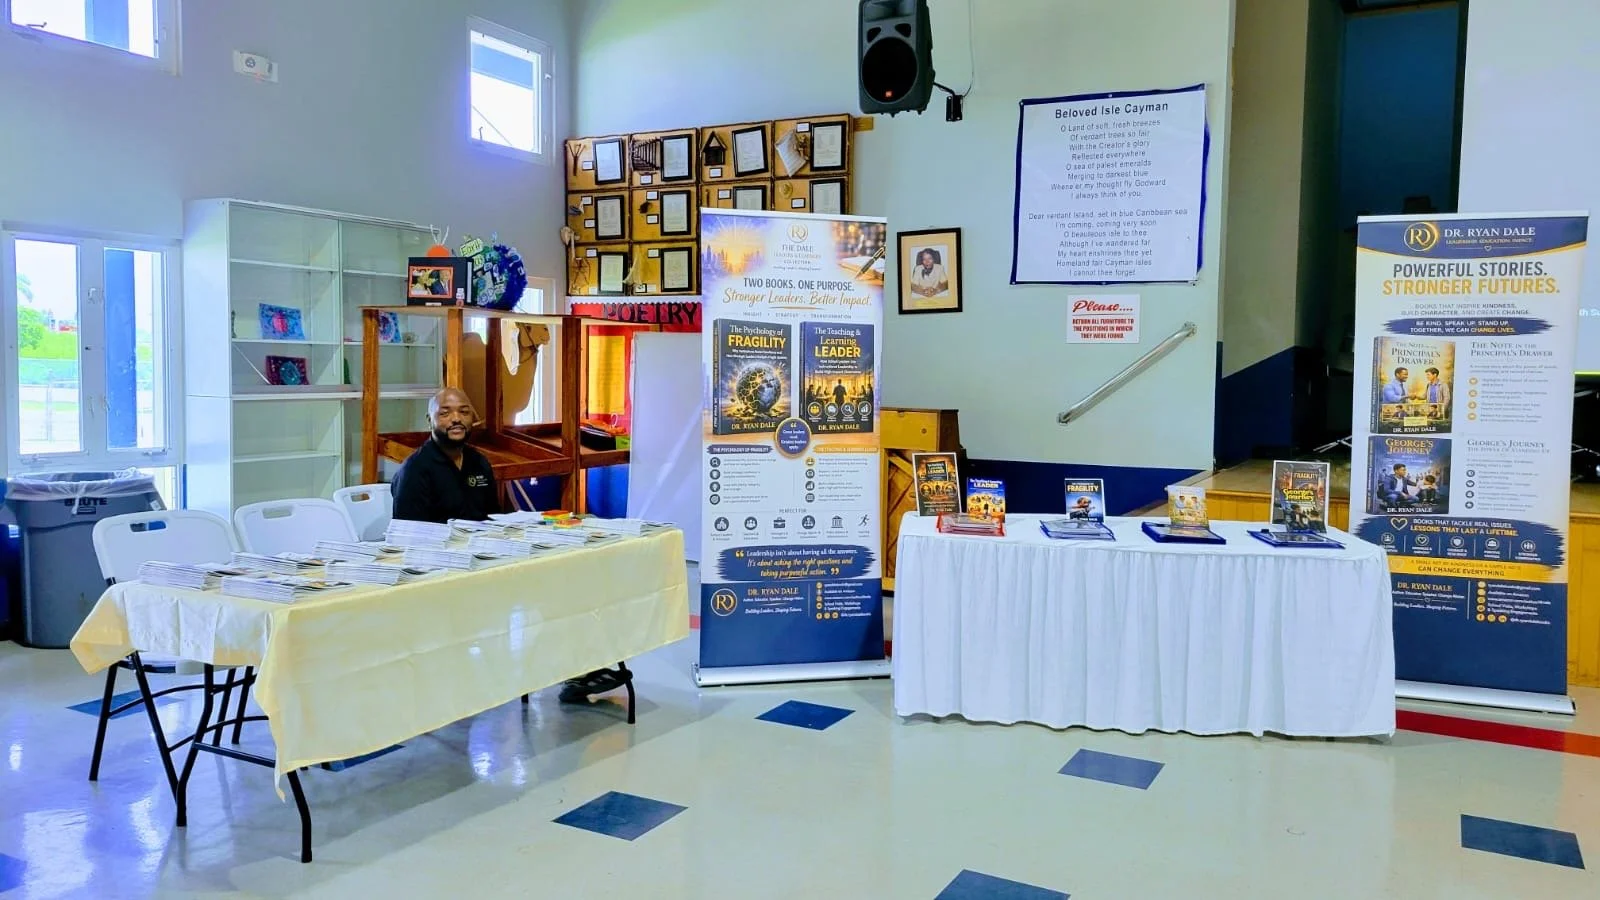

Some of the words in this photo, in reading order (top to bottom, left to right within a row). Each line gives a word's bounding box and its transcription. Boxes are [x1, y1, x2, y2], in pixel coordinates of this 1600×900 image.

[1055, 105, 1097, 118] Beloved
[1102, 104, 1120, 115] Isle
[1125, 103, 1168, 114] Cayman
[1087, 123, 1094, 131] of
[1112, 121, 1130, 129] fresh
[1133, 119, 1160, 127] breezes
[1133, 140, 1150, 148] glory
[1072, 152, 1103, 160] Reflected
[1106, 150, 1145, 159] everywhere
[1097, 161, 1117, 170] palest
[1076, 192, 1097, 200] always
[1445, 229, 1464, 237] DR.
[1468, 228, 1500, 236] RYAN
[1503, 227, 1535, 236] DALE
[1058, 250, 1066, 258] My
[1141, 249, 1152, 257] yet
[1393, 264, 1473, 278] POWERFUL
[1479, 261, 1547, 277] STORIES.
[744, 278, 763, 288] TWO
[766, 279, 795, 289] BOOKS.
[799, 280, 814, 290] ONE
[817, 281, 854, 292] PURPOSE.
[1383, 279, 1472, 295] STRONGER
[1479, 278, 1560, 294] FUTURES.
[723, 288, 765, 307] Stronger
[768, 292, 805, 304] Leaders.
[810, 293, 837, 305] Better
[840, 294, 872, 309] Impact.
[603, 302, 698, 324] POETRY
[730, 325, 742, 333] The
[743, 326, 775, 336] Psychology
[728, 335, 786, 348] FRAGILITY
[821, 337, 856, 347] Learning
[815, 346, 860, 357] LEADER
[1398, 356, 1434, 365] DRAWER
[1385, 439, 1434, 448] GEORGE'S
[1412, 582, 1431, 590] RYAN
[1433, 583, 1452, 591] DALE
